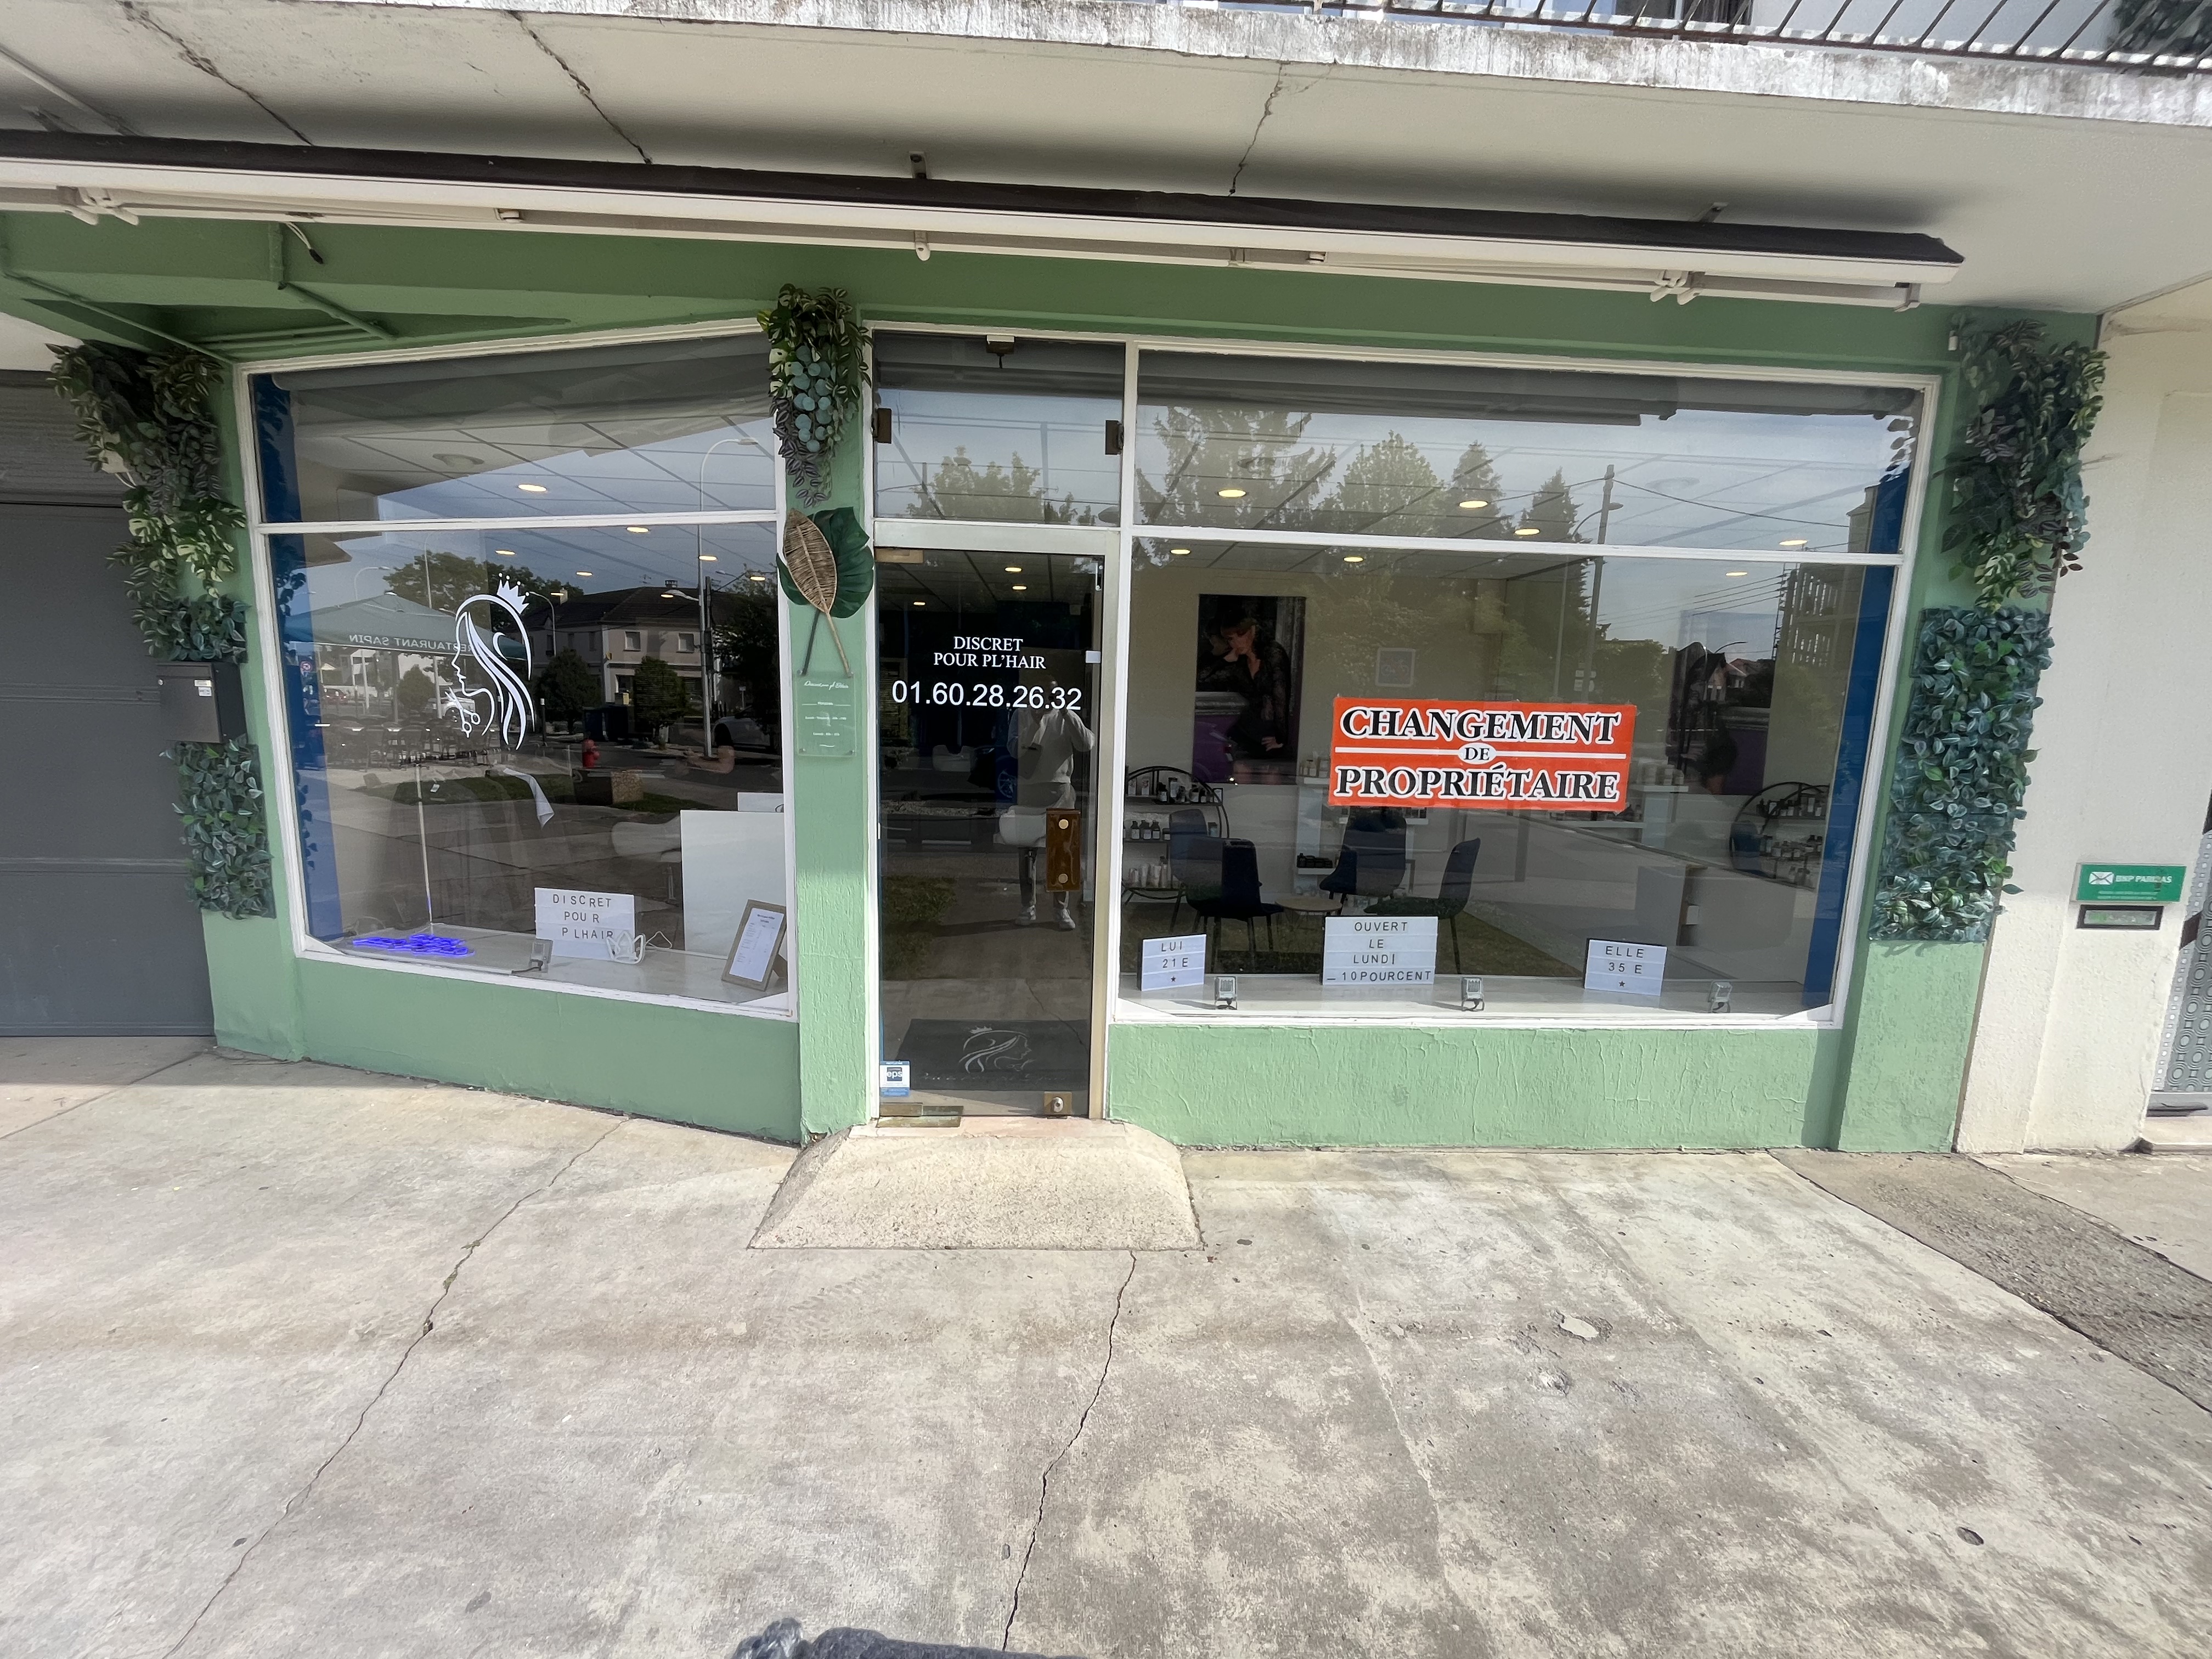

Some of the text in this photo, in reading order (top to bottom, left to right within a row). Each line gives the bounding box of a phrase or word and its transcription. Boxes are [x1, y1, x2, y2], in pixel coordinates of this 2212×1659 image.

[953, 636, 1023, 652] DISCRET
[934, 652, 979, 667] POUR
[892, 680, 1082, 710] 01.60.28.26.32
[1342, 708, 1620, 744] CHANGEMENT
[1464, 747, 1490, 761] DE
[1335, 764, 1619, 800] PROPRIÉTAIRE
[553, 894, 612, 908] DISCRET
[1354, 922, 1407, 932] OUVERT
[1161, 941, 1182, 952] LUI
[1369, 939, 1384, 949] LE
[1353, 953, 1395, 964] LUNDI
[1605, 946, 1644, 958] ELLE
[1163, 957, 1188, 968] 21 E
[1609, 962, 1643, 974] 35 E
